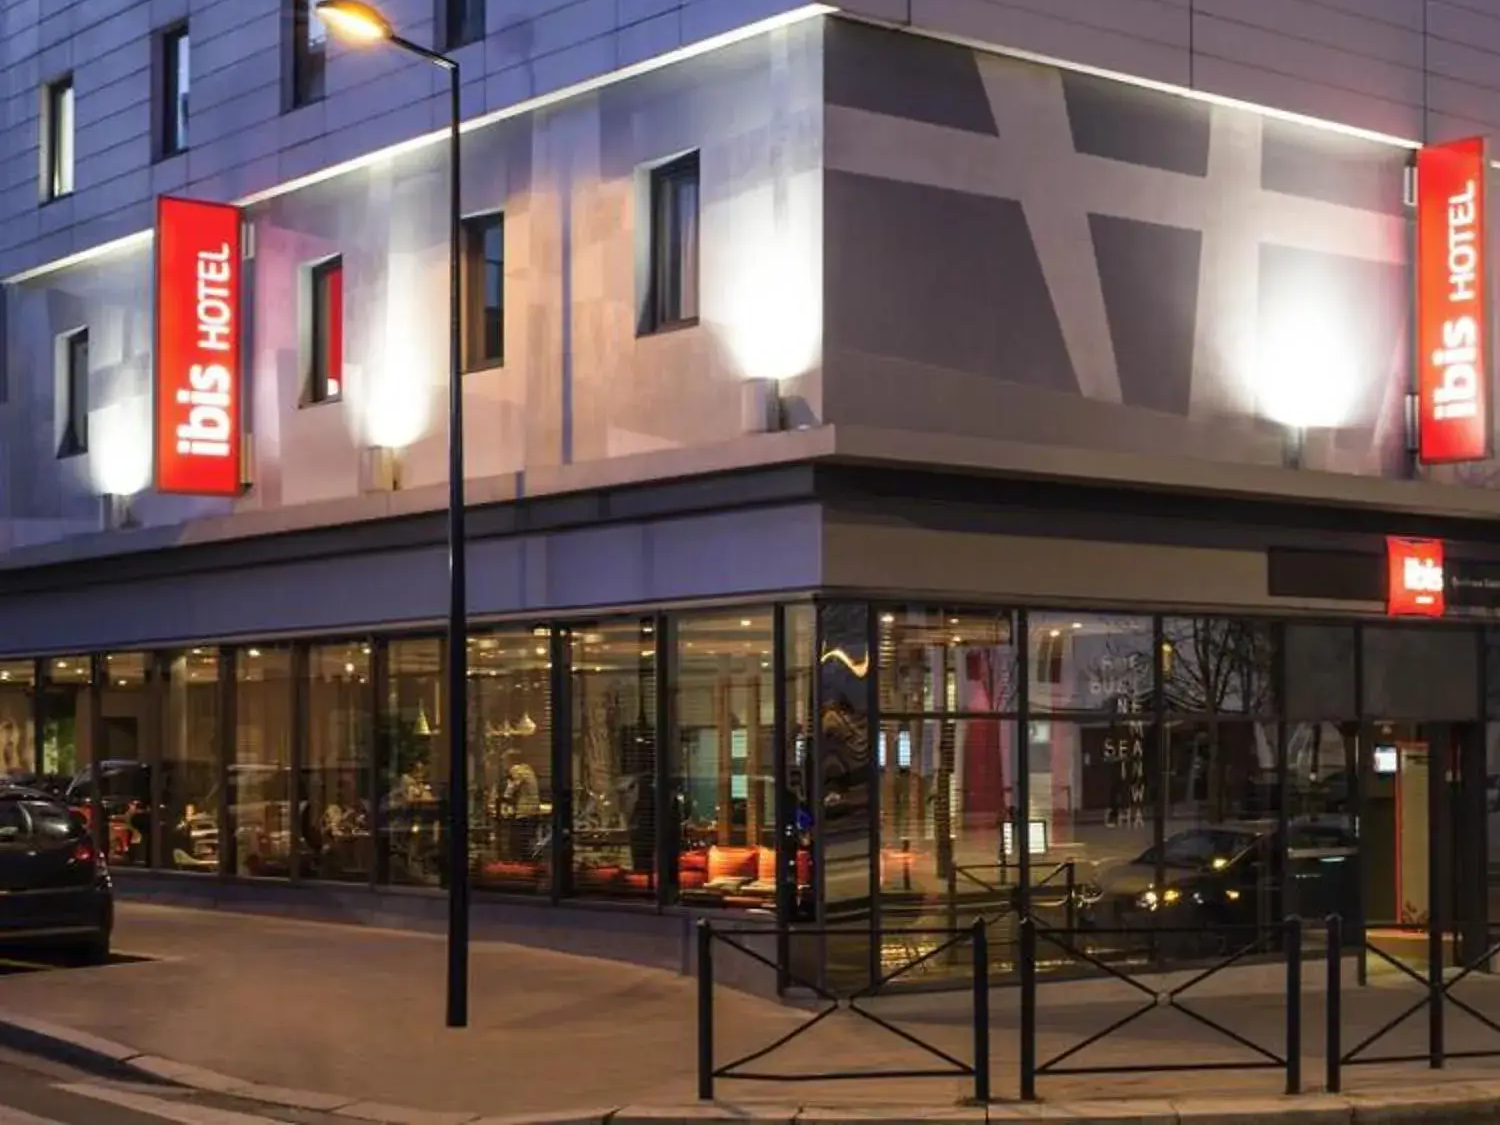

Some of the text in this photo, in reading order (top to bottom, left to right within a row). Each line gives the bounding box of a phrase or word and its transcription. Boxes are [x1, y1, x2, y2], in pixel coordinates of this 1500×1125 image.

[176, 242, 231, 457] ibis HOTEL
[1432, 179, 1477, 421] ibis HOTEL
